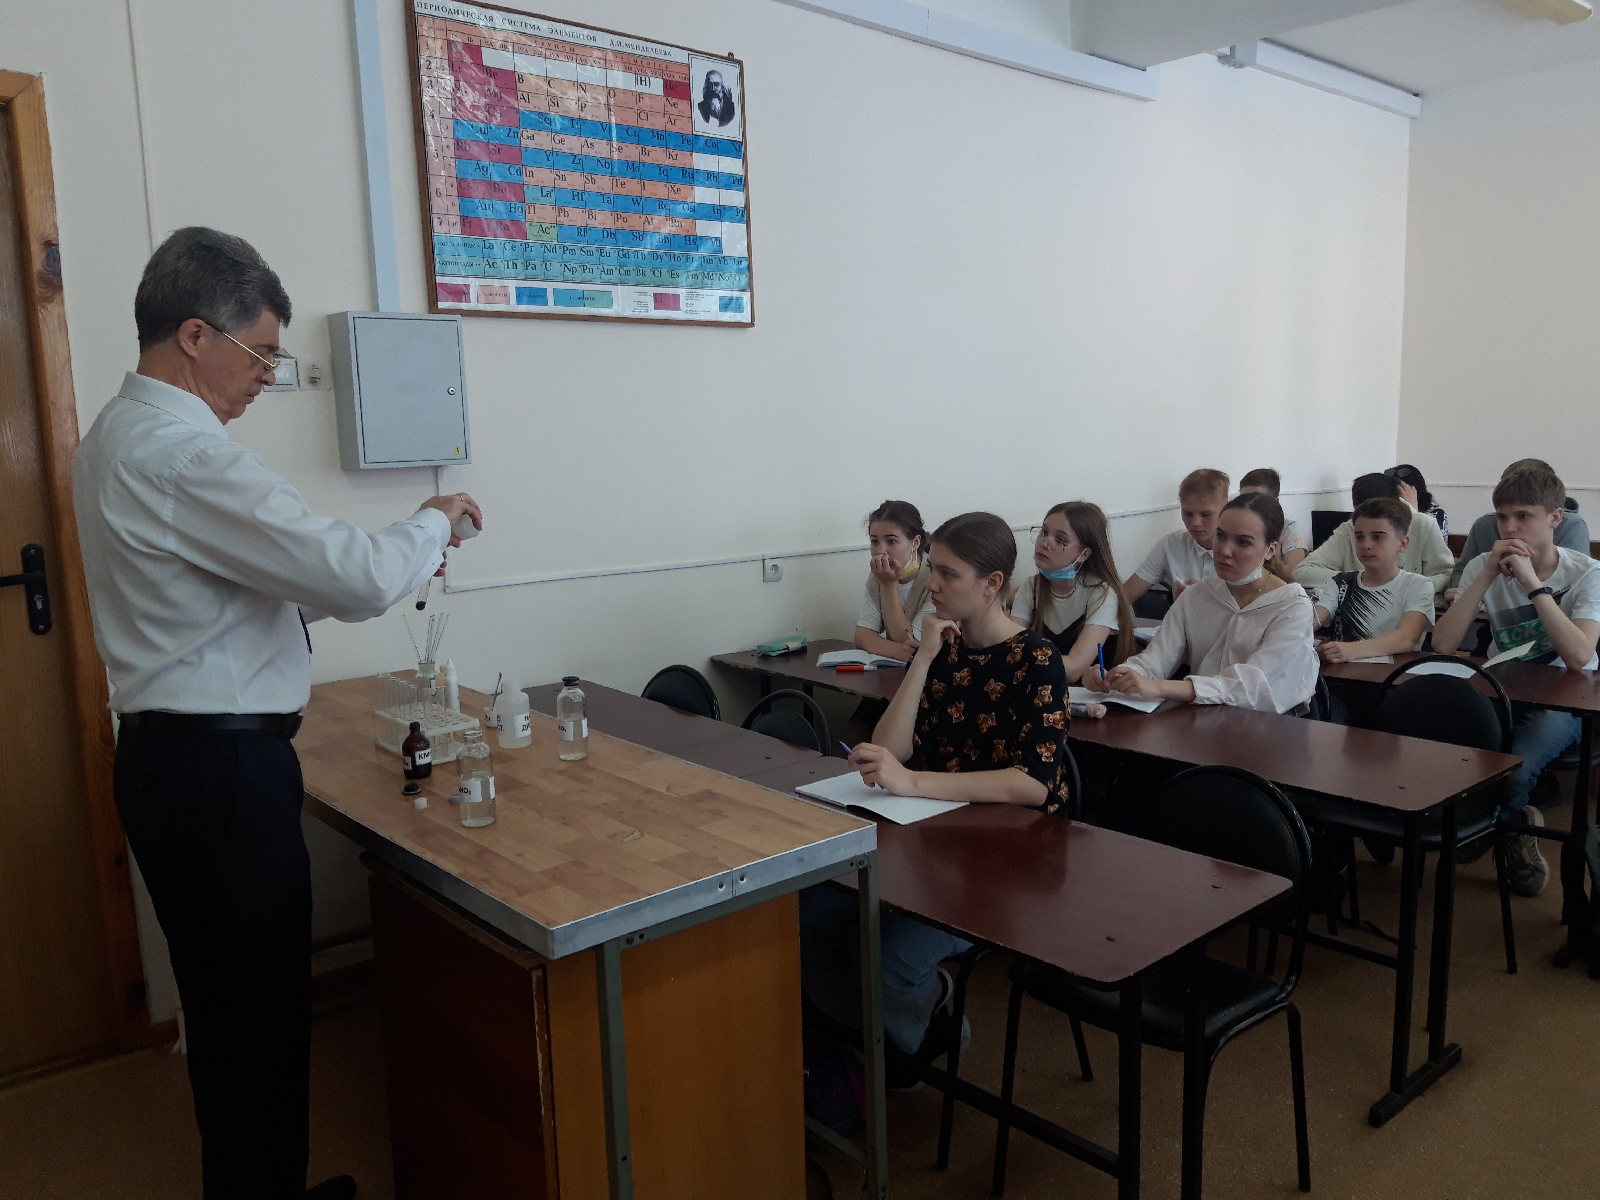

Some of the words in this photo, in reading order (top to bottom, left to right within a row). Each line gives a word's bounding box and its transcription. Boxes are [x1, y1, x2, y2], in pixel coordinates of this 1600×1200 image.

[416, 1, 494, 23] ПЕРИОДИЧЕСКАЯ
[501, 17, 541, 32] СИСТЕМА
[547, 27, 597, 42] ЭЛЕМЕНТОВ
[485, 67, 499, 79] Be
[517, 72, 525, 84] B
[547, 78, 555, 89] C
[579, 83, 587, 95] N
[607, 88, 616, 99] O
[637, 93, 644, 103] F
[665, 97, 679, 109] Ne
[519, 93, 531, 104] Al
[549, 96, 560, 108] Si
[638, 110, 649, 122] Cl
[666, 115, 678, 126] Ar
[505, 129, 519, 140] Zn
[521, 129, 535, 141] Ga
[552, 132, 566, 145] Ge
[582, 139, 595, 150] As
[640, 146, 652, 157] Br
[667, 150, 679, 161] Kr
[599, 122, 609, 133] V
[626, 126, 638, 138] Cr
[651, 130, 665, 141] Mn
[681, 134, 692, 146] Fe
[704, 138, 717, 149] Co
[474, 161, 489, 177] Ag
[507, 164, 523, 177] Cd
[524, 167, 535, 178] In
[554, 170, 567, 182] Sn
[584, 174, 596, 185] Sb
[613, 178, 626, 189] Te
[669, 184, 682, 195] Xe
[544, 150, 552, 162] Y
[596, 158, 611, 170] Nb
[626, 161, 641, 174] Mo
[681, 168, 694, 180] Ru
[706, 171, 718, 183] Rh
[435, 187, 442, 198] 6
[571, 190, 585, 202] Hf
[600, 193, 612, 205] Ta
[631, 197, 642, 208] W
[657, 199, 669, 211] Re
[682, 202, 695, 213] Os
[476, 199, 491, 211] Au
[508, 202, 524, 216] Hg
[556, 206, 570, 219] Pb
[587, 210, 597, 221] Bi
[615, 212, 628, 224] Po
[670, 217, 683, 229] Rn
[483, 239, 494, 250] La
[503, 241, 517, 252] Ce
[524, 242, 535, 253] Pr
[543, 244, 558, 255] Nd
[562, 245, 577, 256] Pm
[580, 246, 594, 257] Sm
[599, 248, 611, 258] Eu
[617, 249, 630, 260] Gd
[652, 252, 664, 264] Dy
[669, 253, 682, 263] Ho
[601, 229, 616, 240] Db
[684, 235, 697, 246] Hs
[484, 259, 498, 269] Ac
[504, 259, 518, 270] Th
[524, 260, 537, 271] Pa
[544, 262, 552, 272] U
[563, 263, 578, 276] Np
[582, 264, 594, 275] Pu
[600, 266, 614, 276] Am
[618, 267, 632, 277] Cm
[636, 268, 647, 277] Bk
[670, 269, 680, 279] Es
